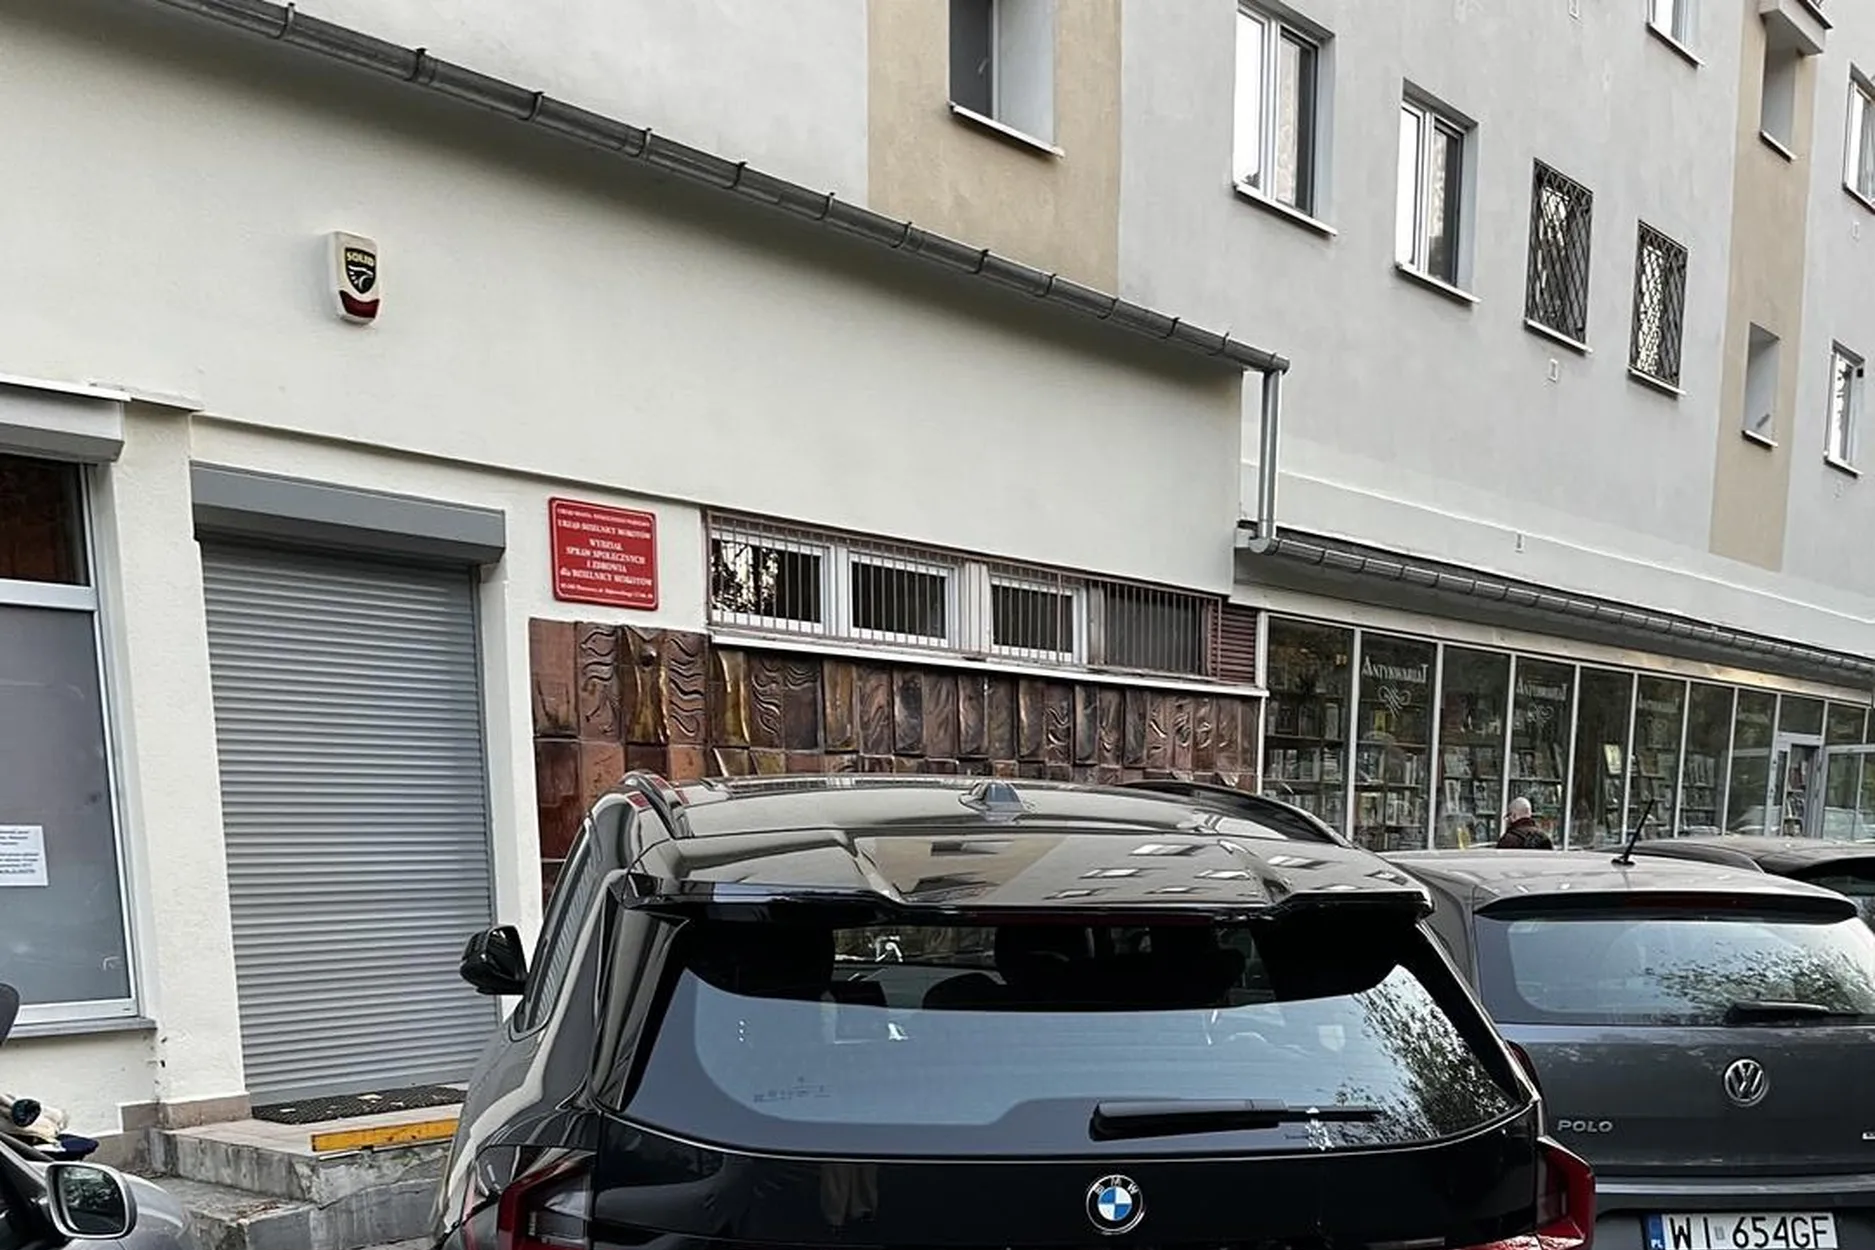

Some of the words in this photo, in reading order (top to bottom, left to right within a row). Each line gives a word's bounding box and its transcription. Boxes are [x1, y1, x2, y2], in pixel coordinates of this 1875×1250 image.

[346, 251, 375, 267] SOLID
[1557, 1118, 1614, 1134] POLO
[1668, 1216, 1712, 1250] WI
[1732, 1215, 1829, 1249] 654GF
